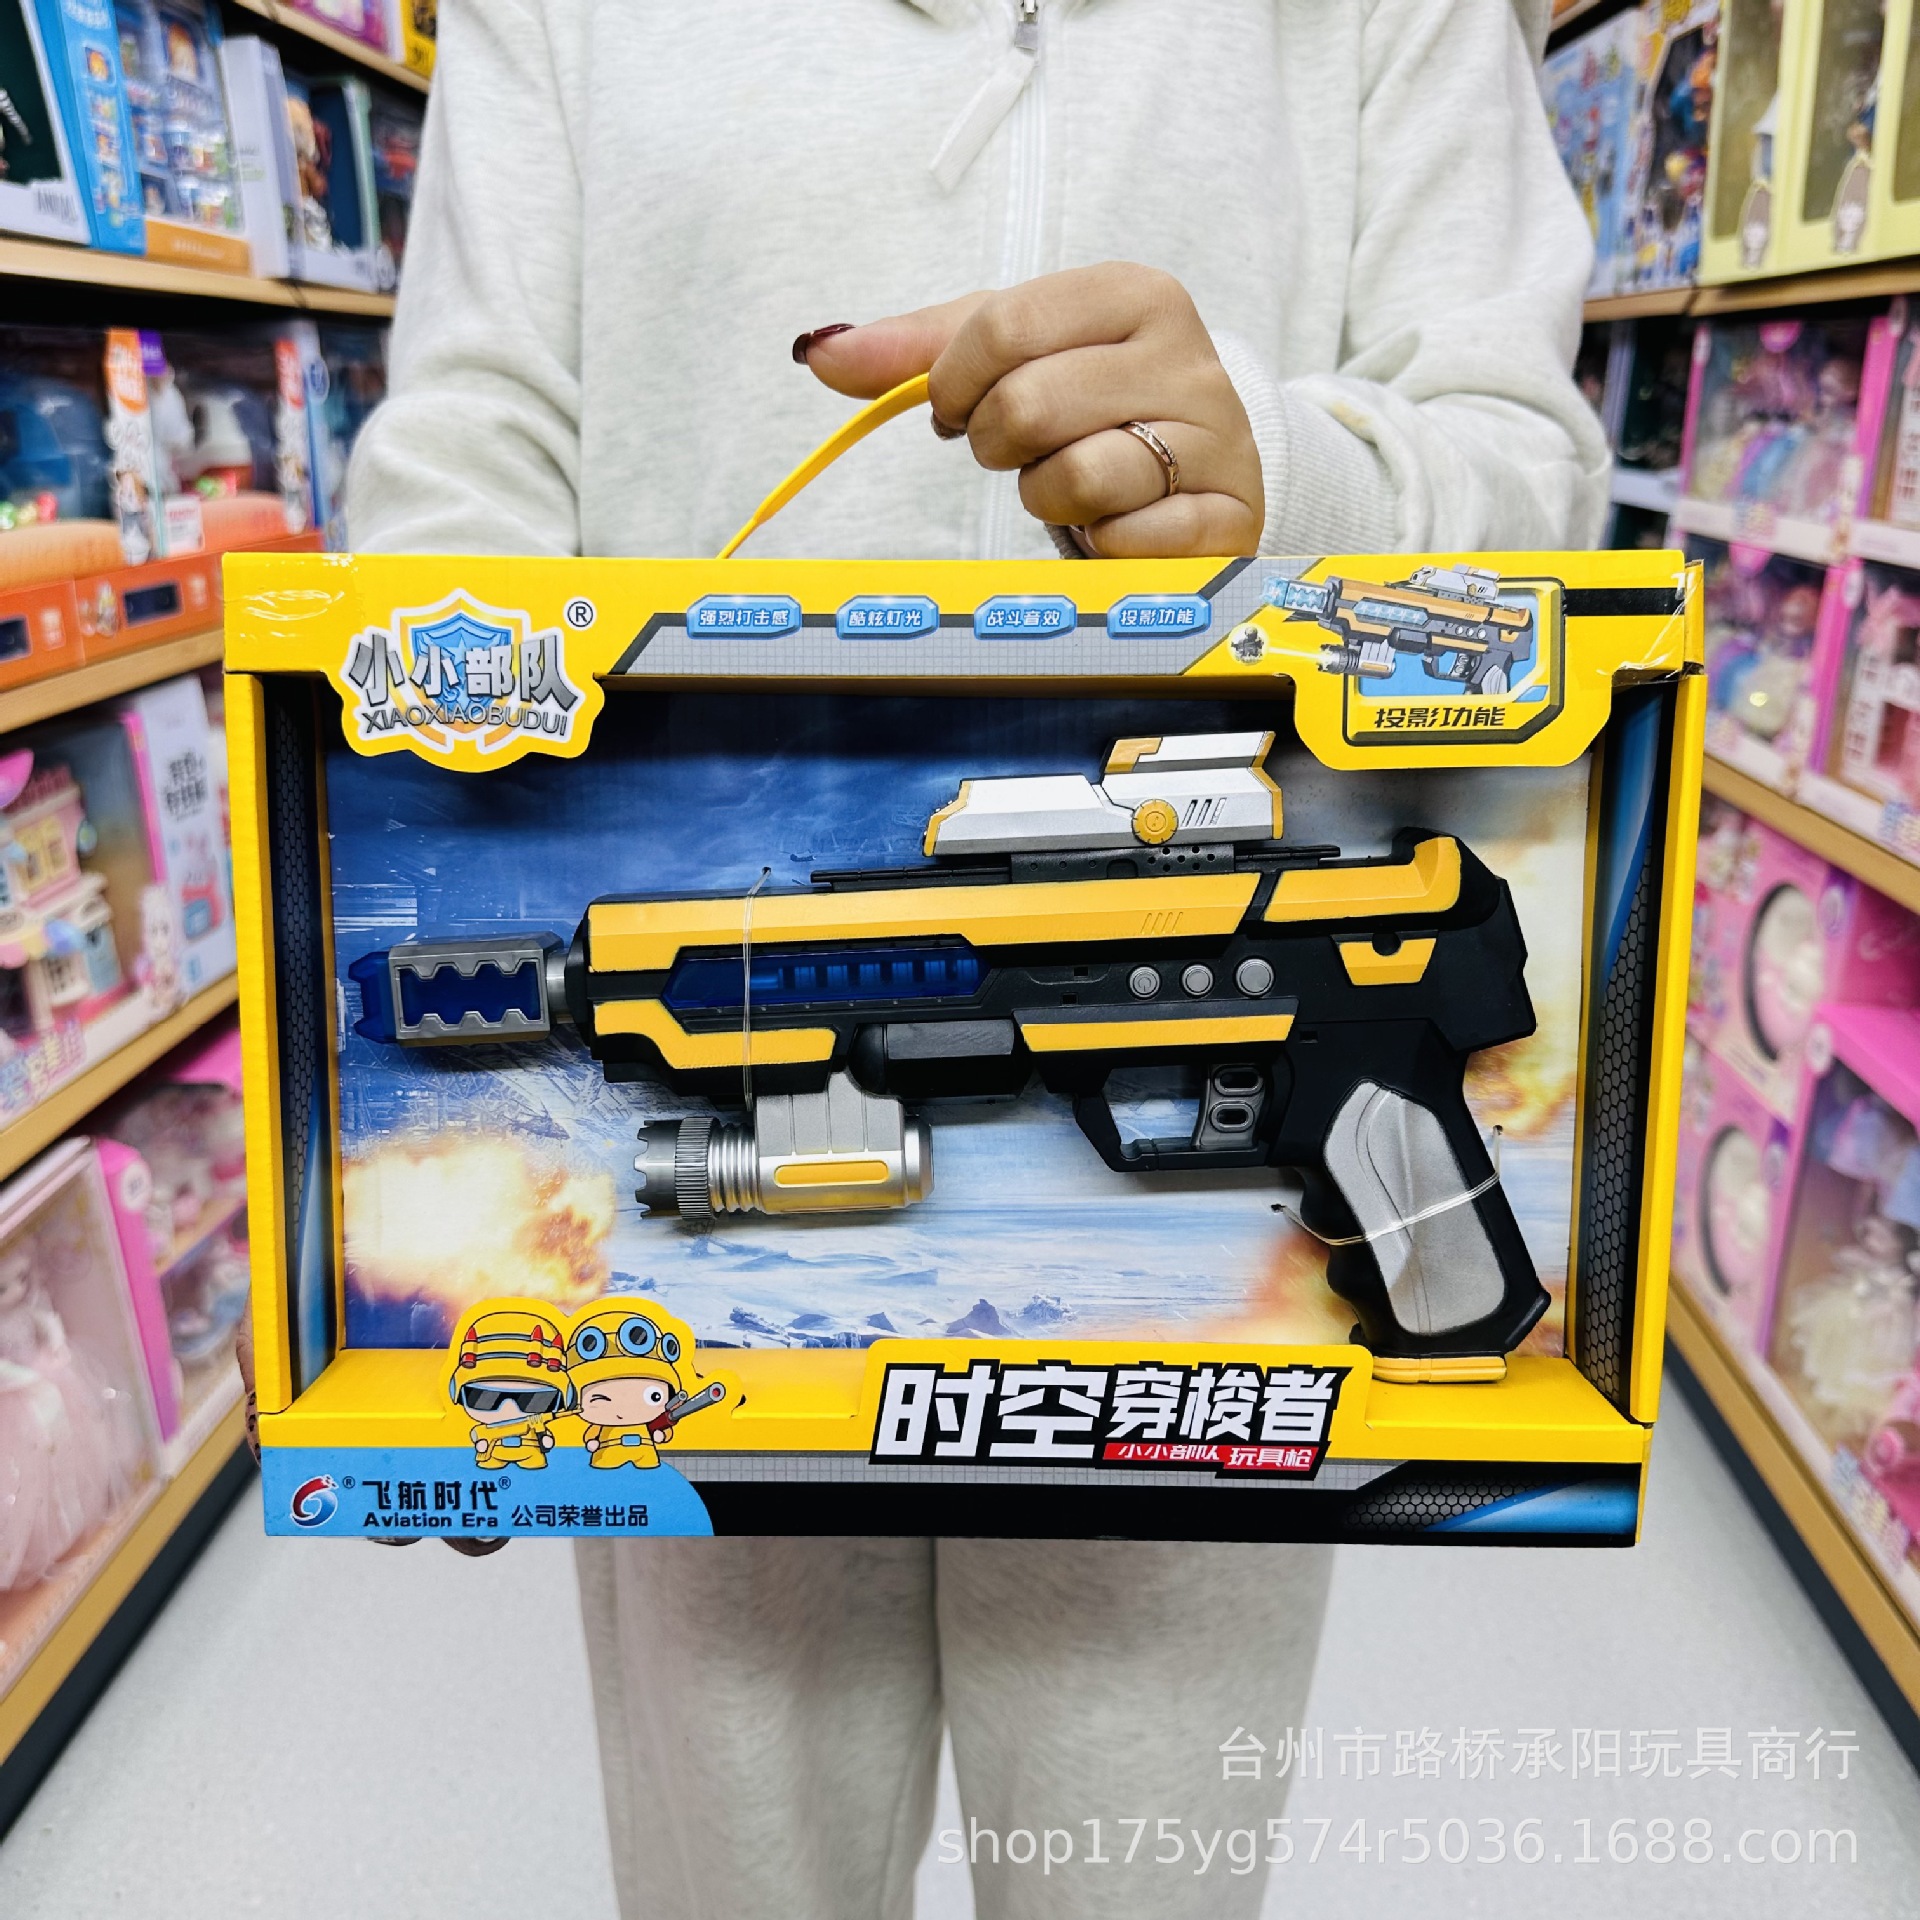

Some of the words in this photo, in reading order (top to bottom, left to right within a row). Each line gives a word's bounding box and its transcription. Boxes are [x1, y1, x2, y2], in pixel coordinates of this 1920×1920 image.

[699, 608, 789, 627] 强烈打击感
[848, 609, 922, 627] 酷炫灯光
[986, 609, 1061, 627] 战斗音效
[1120, 608, 1195, 626] 投影功能
[348, 633, 578, 712] 小小部队
[361, 705, 568, 736] XIAOXIAOBUDUI
[1374, 706, 1506, 728] 投影功能
[875, 1364, 1336, 1459] 时空穿梭者
[1118, 1443, 1221, 1461] 小小部队
[1228, 1447, 1312, 1469] 玩具枪
[362, 1480, 498, 1511] 飞航时代
[363, 1511, 451, 1528] Aviation
[461, 1511, 499, 1528] Era
[511, 1504, 649, 1528] 公司荣誉出品
